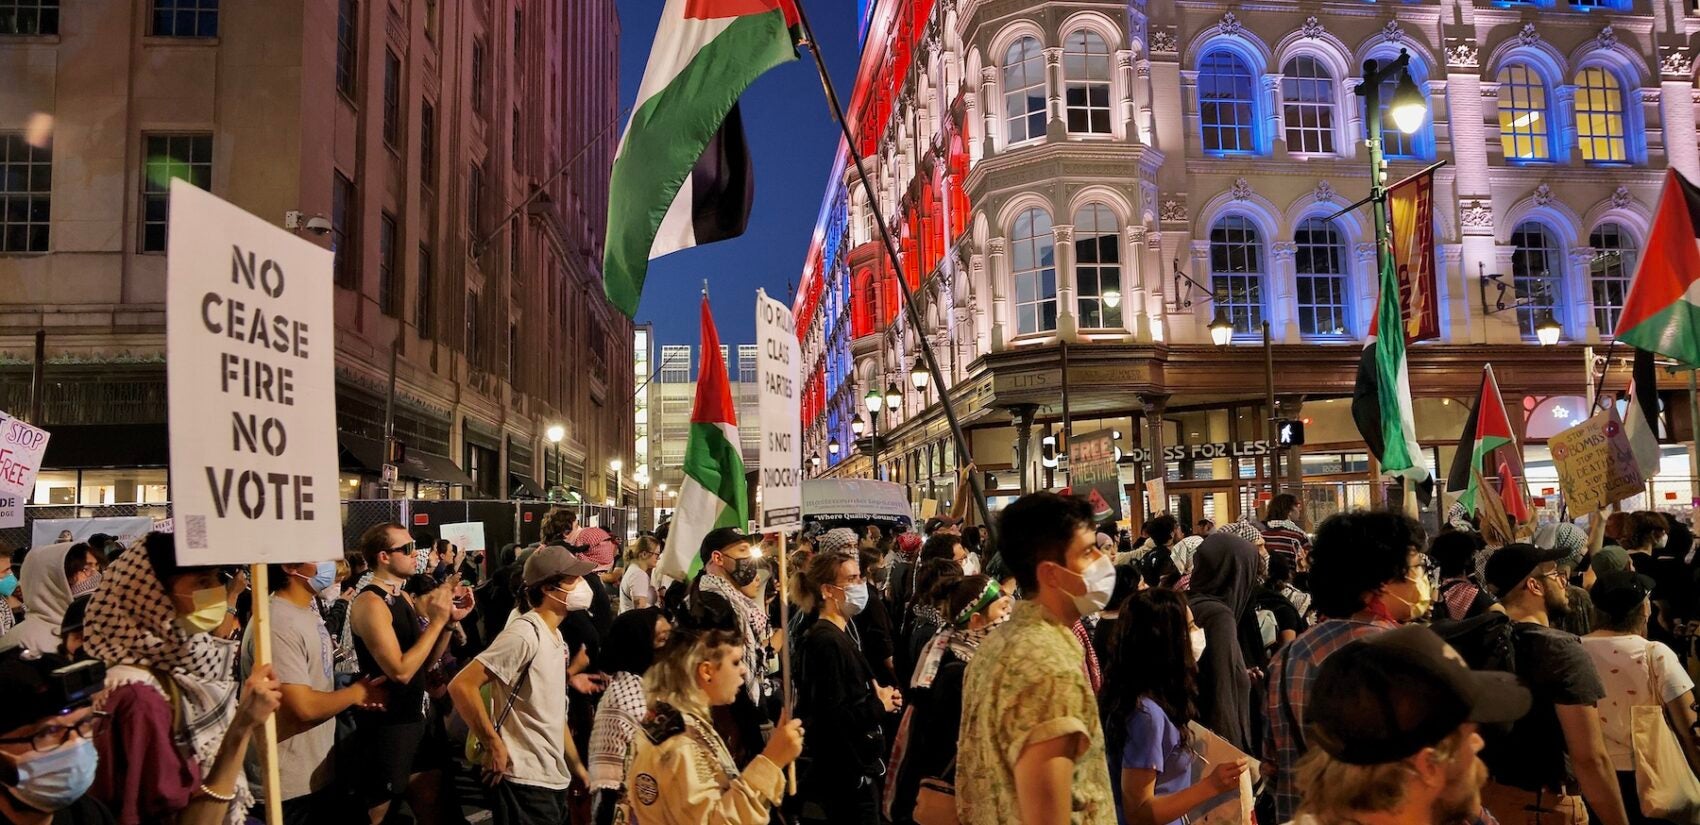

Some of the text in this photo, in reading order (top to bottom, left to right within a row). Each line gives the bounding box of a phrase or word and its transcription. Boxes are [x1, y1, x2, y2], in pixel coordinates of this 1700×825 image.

[231, 244, 285, 298] NO
[201, 292, 309, 359] CEASE
[221, 352, 294, 406] FIRE
[8, 423, 44, 448] STOP
[232, 411, 287, 457] NO
[775, 432, 792, 453] NOT
[1566, 429, 1585, 443] STOP
[1569, 433, 1606, 457] BOMBS
[1070, 437, 1113, 463] FREE
[1133, 446, 1185, 462] DRSS
[1192, 443, 1227, 458] FOR
[1576, 452, 1593, 466] STOP
[0, 448, 30, 486] FREE
[1576, 456, 1616, 478] DEATHS
[204, 466, 315, 521] VOTE
[1578, 471, 1637, 505] DESTRUCTION
